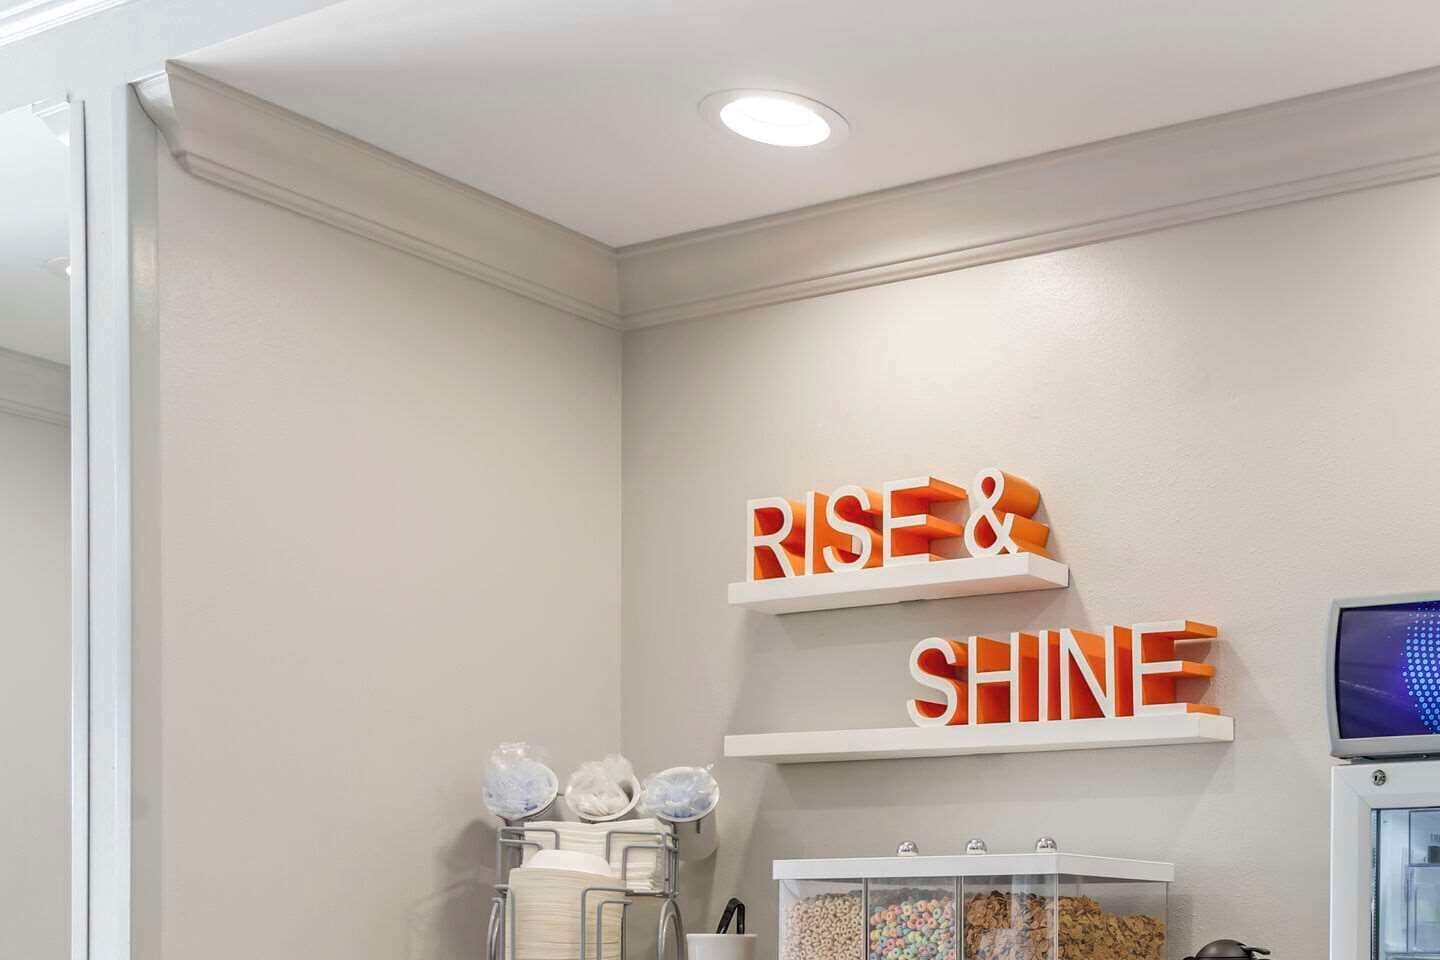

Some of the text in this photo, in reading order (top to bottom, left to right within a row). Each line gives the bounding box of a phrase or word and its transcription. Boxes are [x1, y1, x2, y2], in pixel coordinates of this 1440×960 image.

[747, 467, 1022, 581] RISE &
[907, 619, 1190, 728] SHINE
